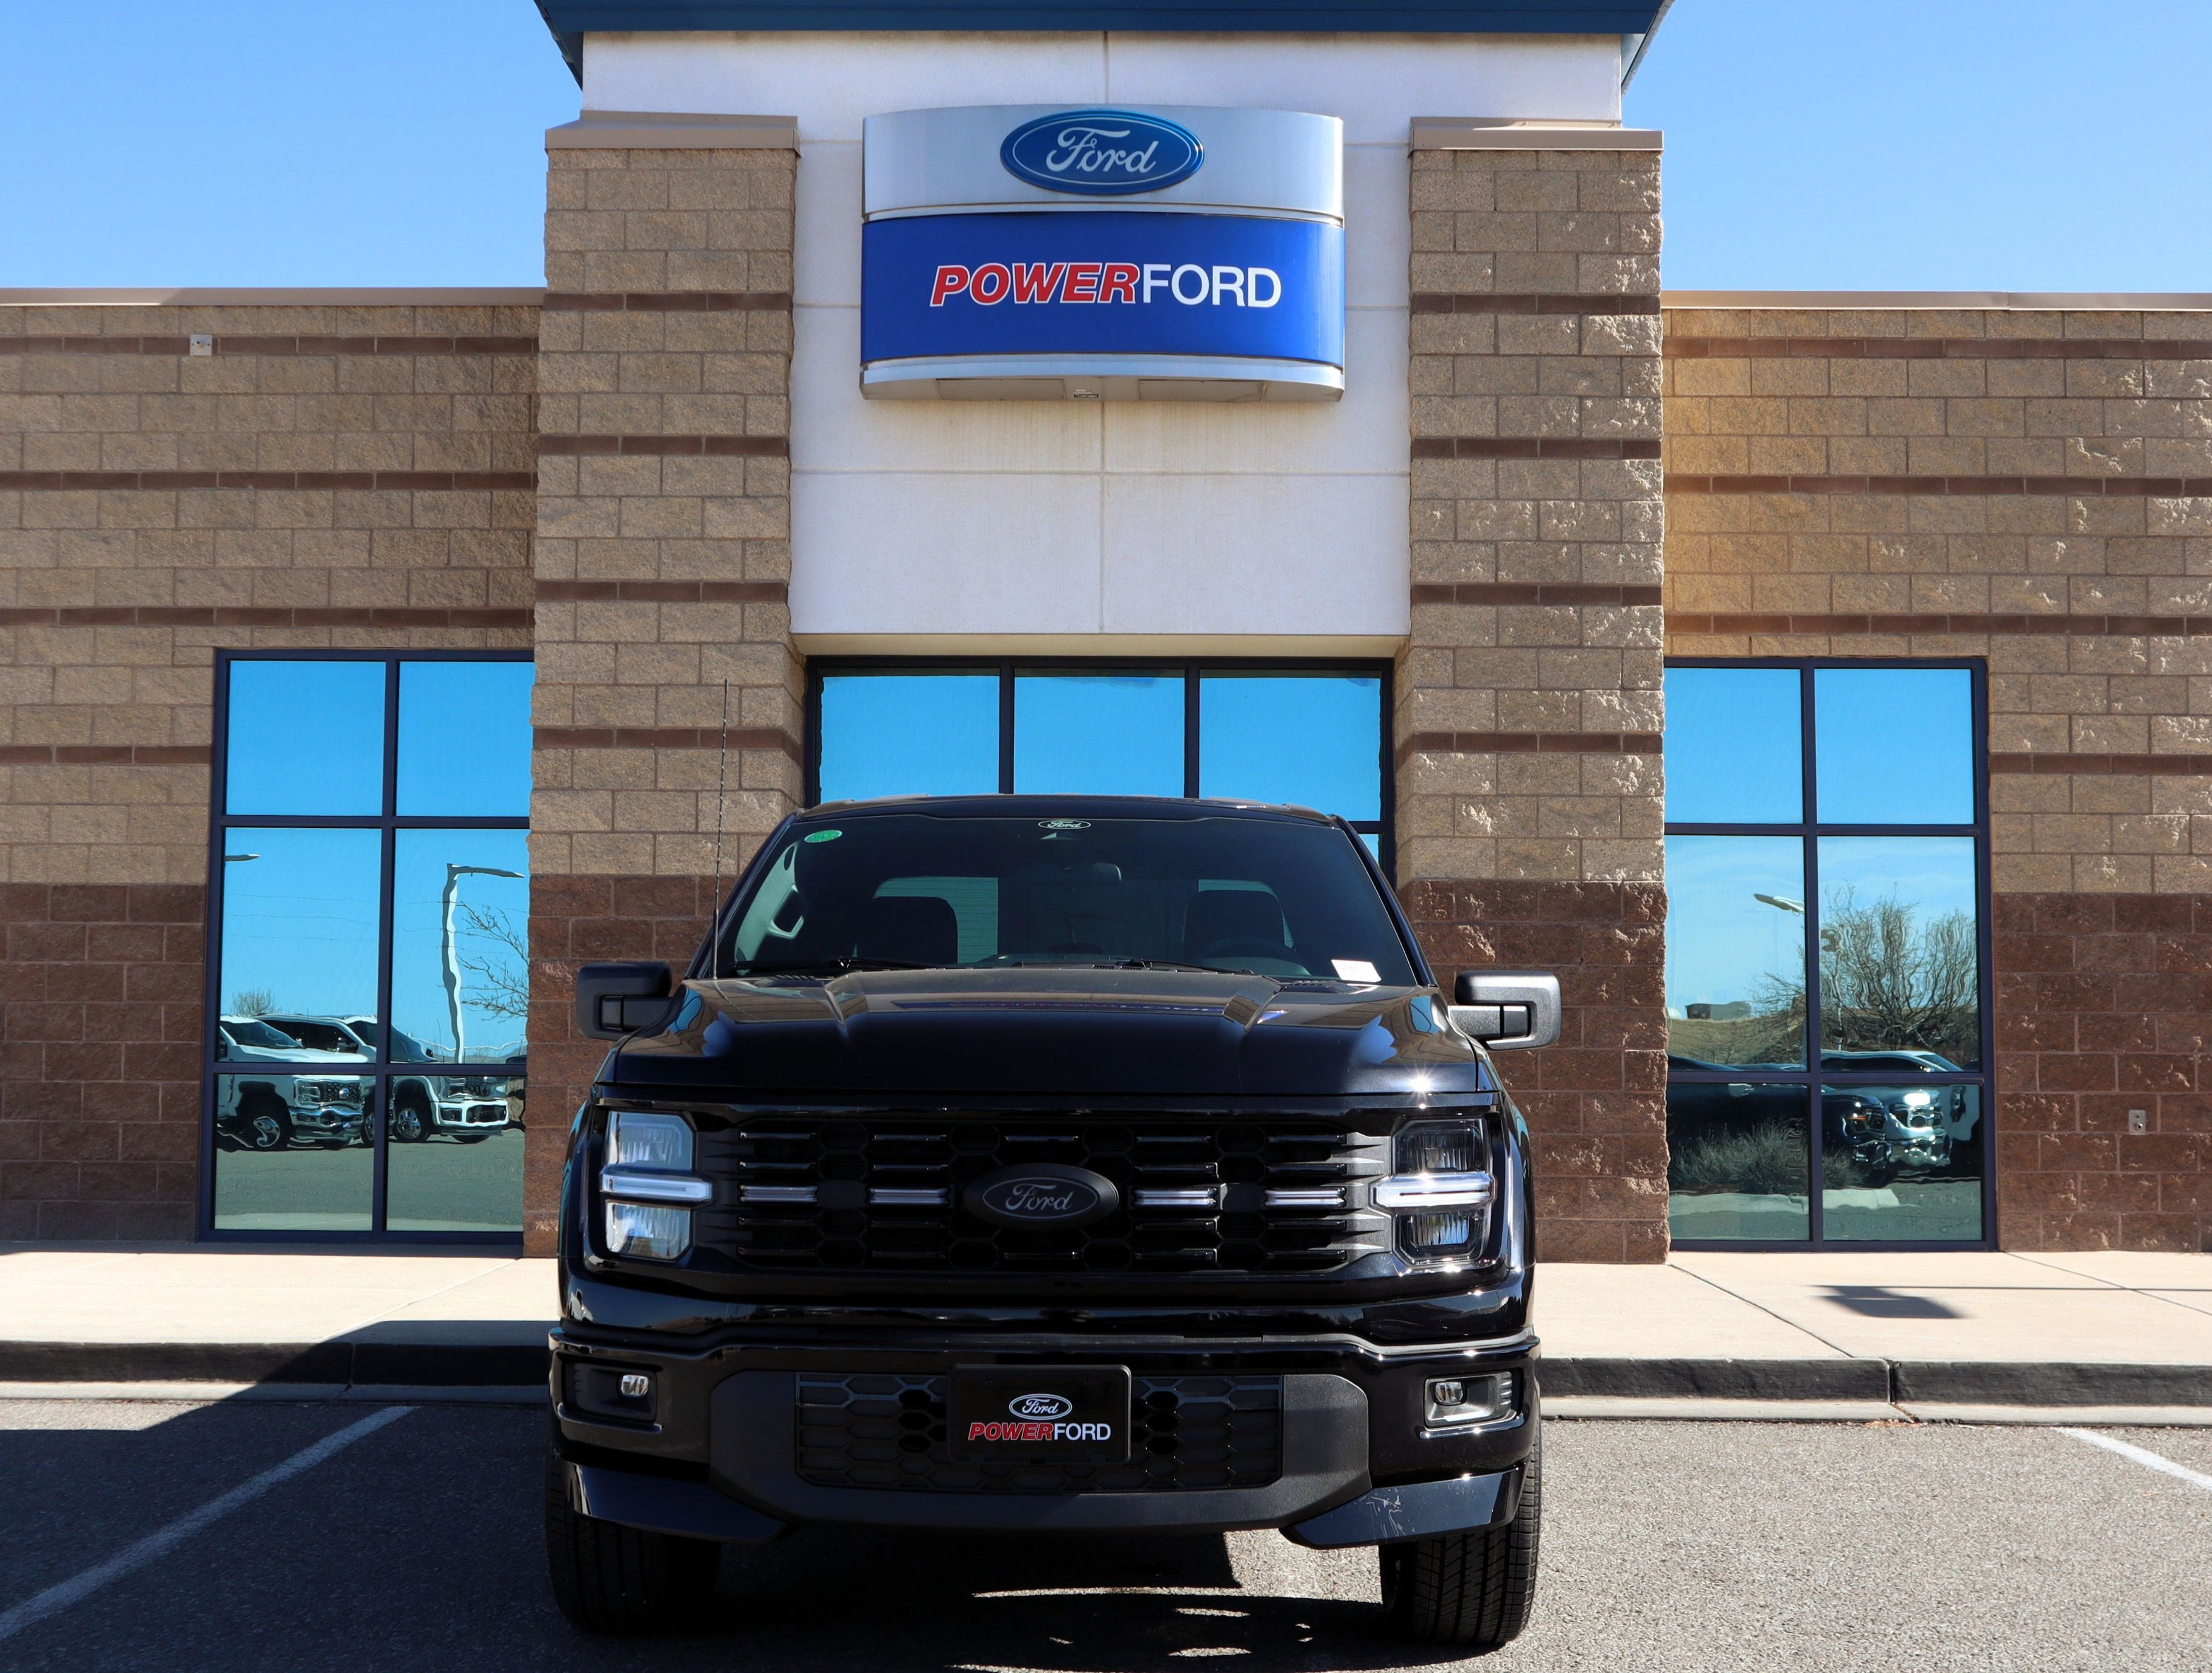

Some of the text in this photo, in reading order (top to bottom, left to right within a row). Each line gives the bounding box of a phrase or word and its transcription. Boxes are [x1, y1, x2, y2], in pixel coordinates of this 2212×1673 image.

[1046, 127, 1158, 173] Ford
[1005, 1183, 1074, 1210] Ford
[1021, 1399, 1058, 1414] Ford
